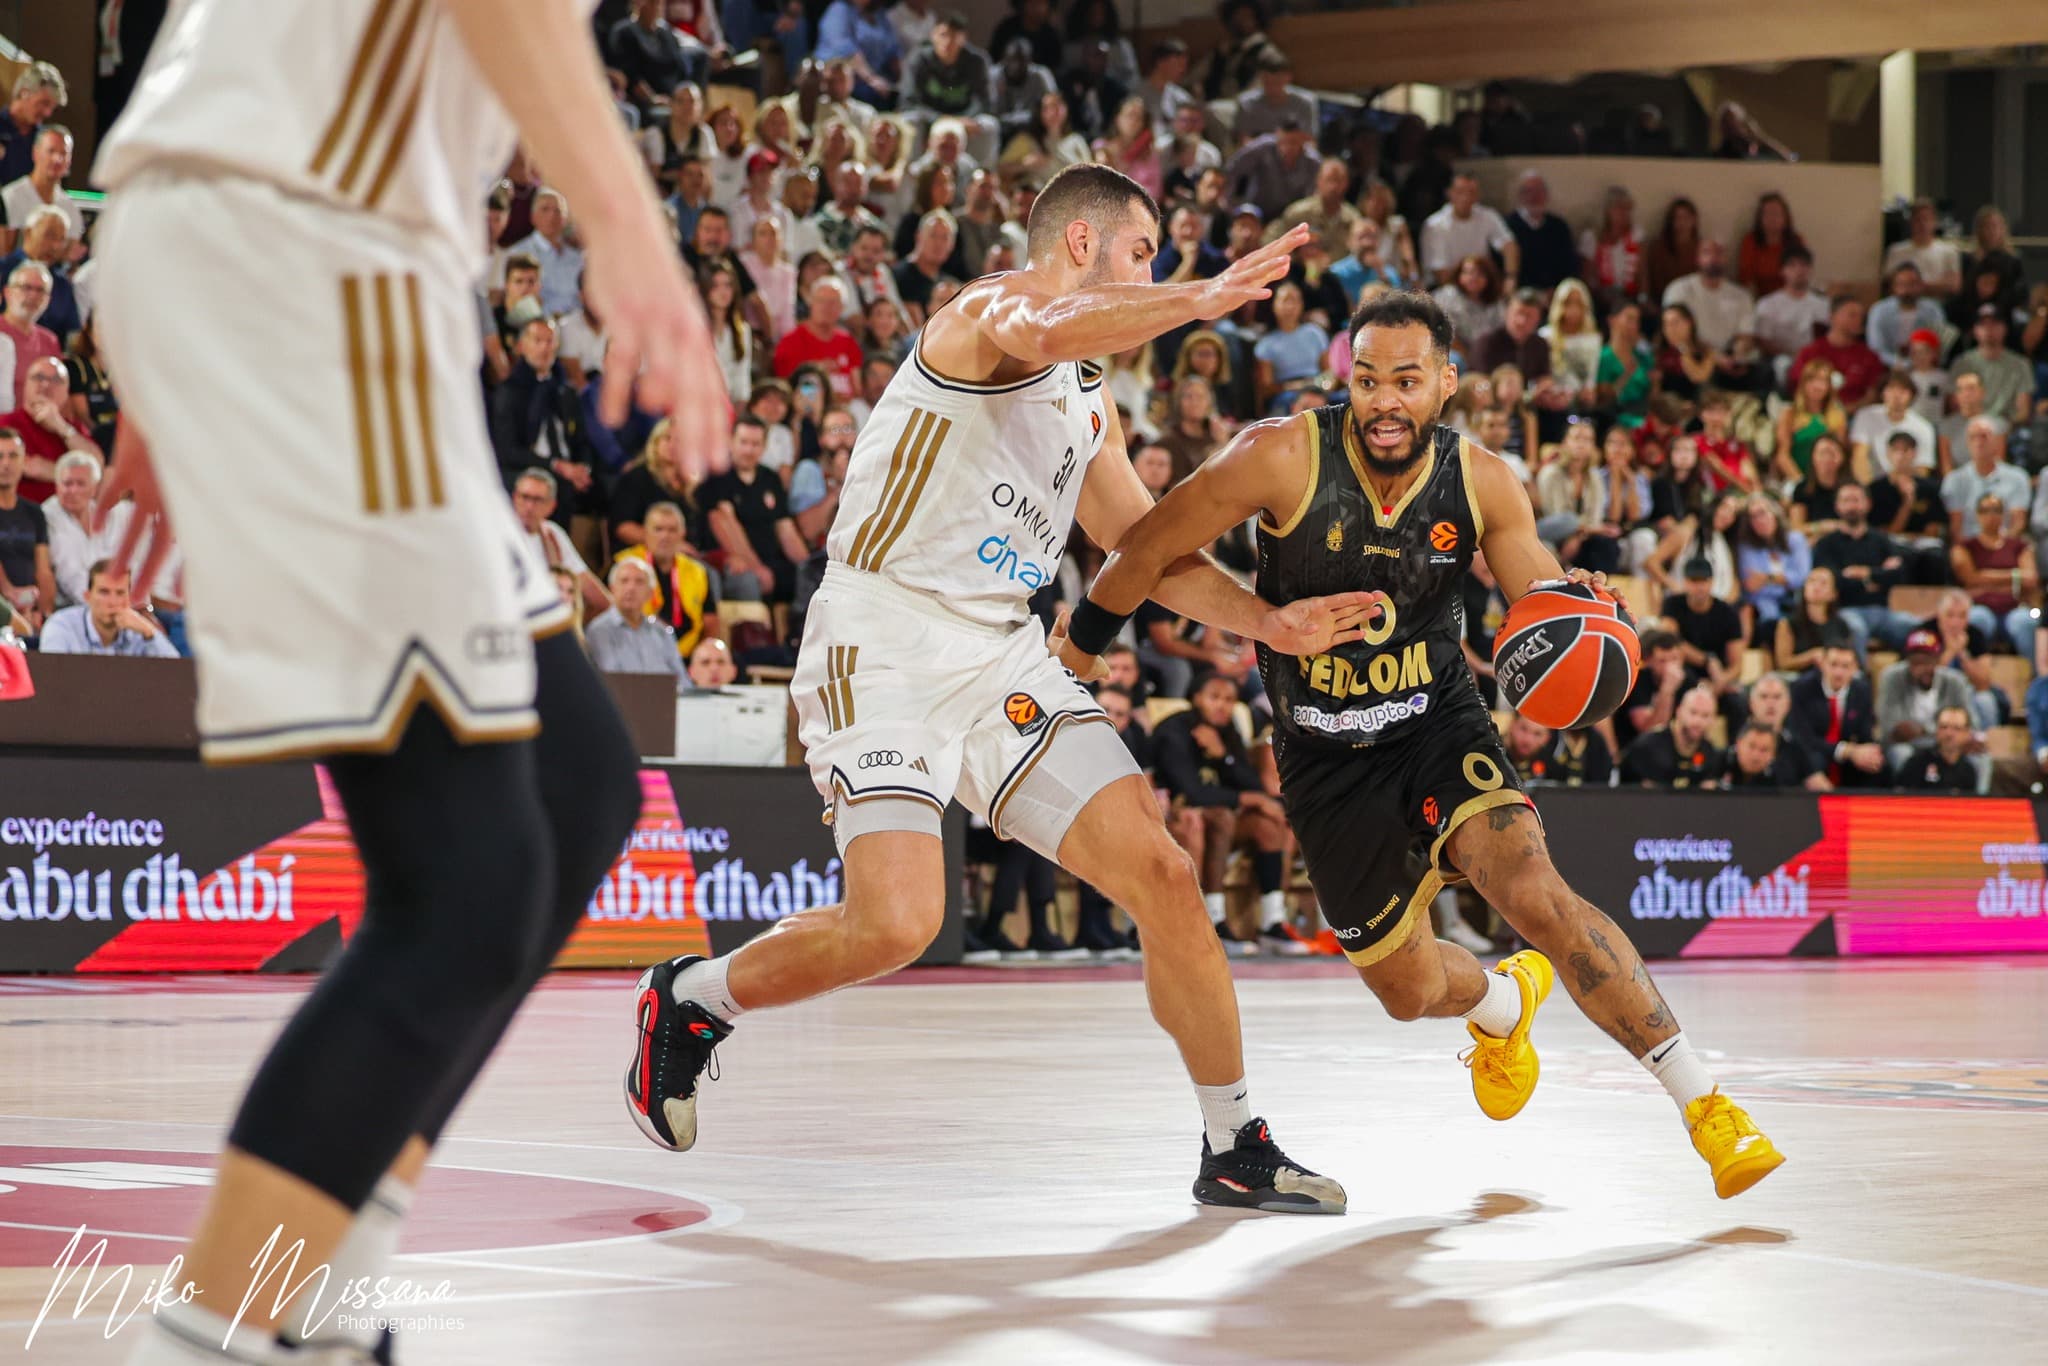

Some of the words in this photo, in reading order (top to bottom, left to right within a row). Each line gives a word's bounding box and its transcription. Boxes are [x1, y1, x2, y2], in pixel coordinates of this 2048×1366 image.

[1363, 544, 1400, 558] SPALDING
[1463, 752, 1504, 791] 0
[0, 811, 165, 853] experience
[1634, 834, 1733, 866] experience
[0, 851, 112, 921] abu
[122, 852, 297, 921] dhabi
[586, 859, 687, 922] abu
[693, 857, 843, 921] dhabi
[1630, 865, 1703, 920] abu
[1705, 864, 1810, 920] dhabi
[1366, 894, 1400, 930] SPALDING
